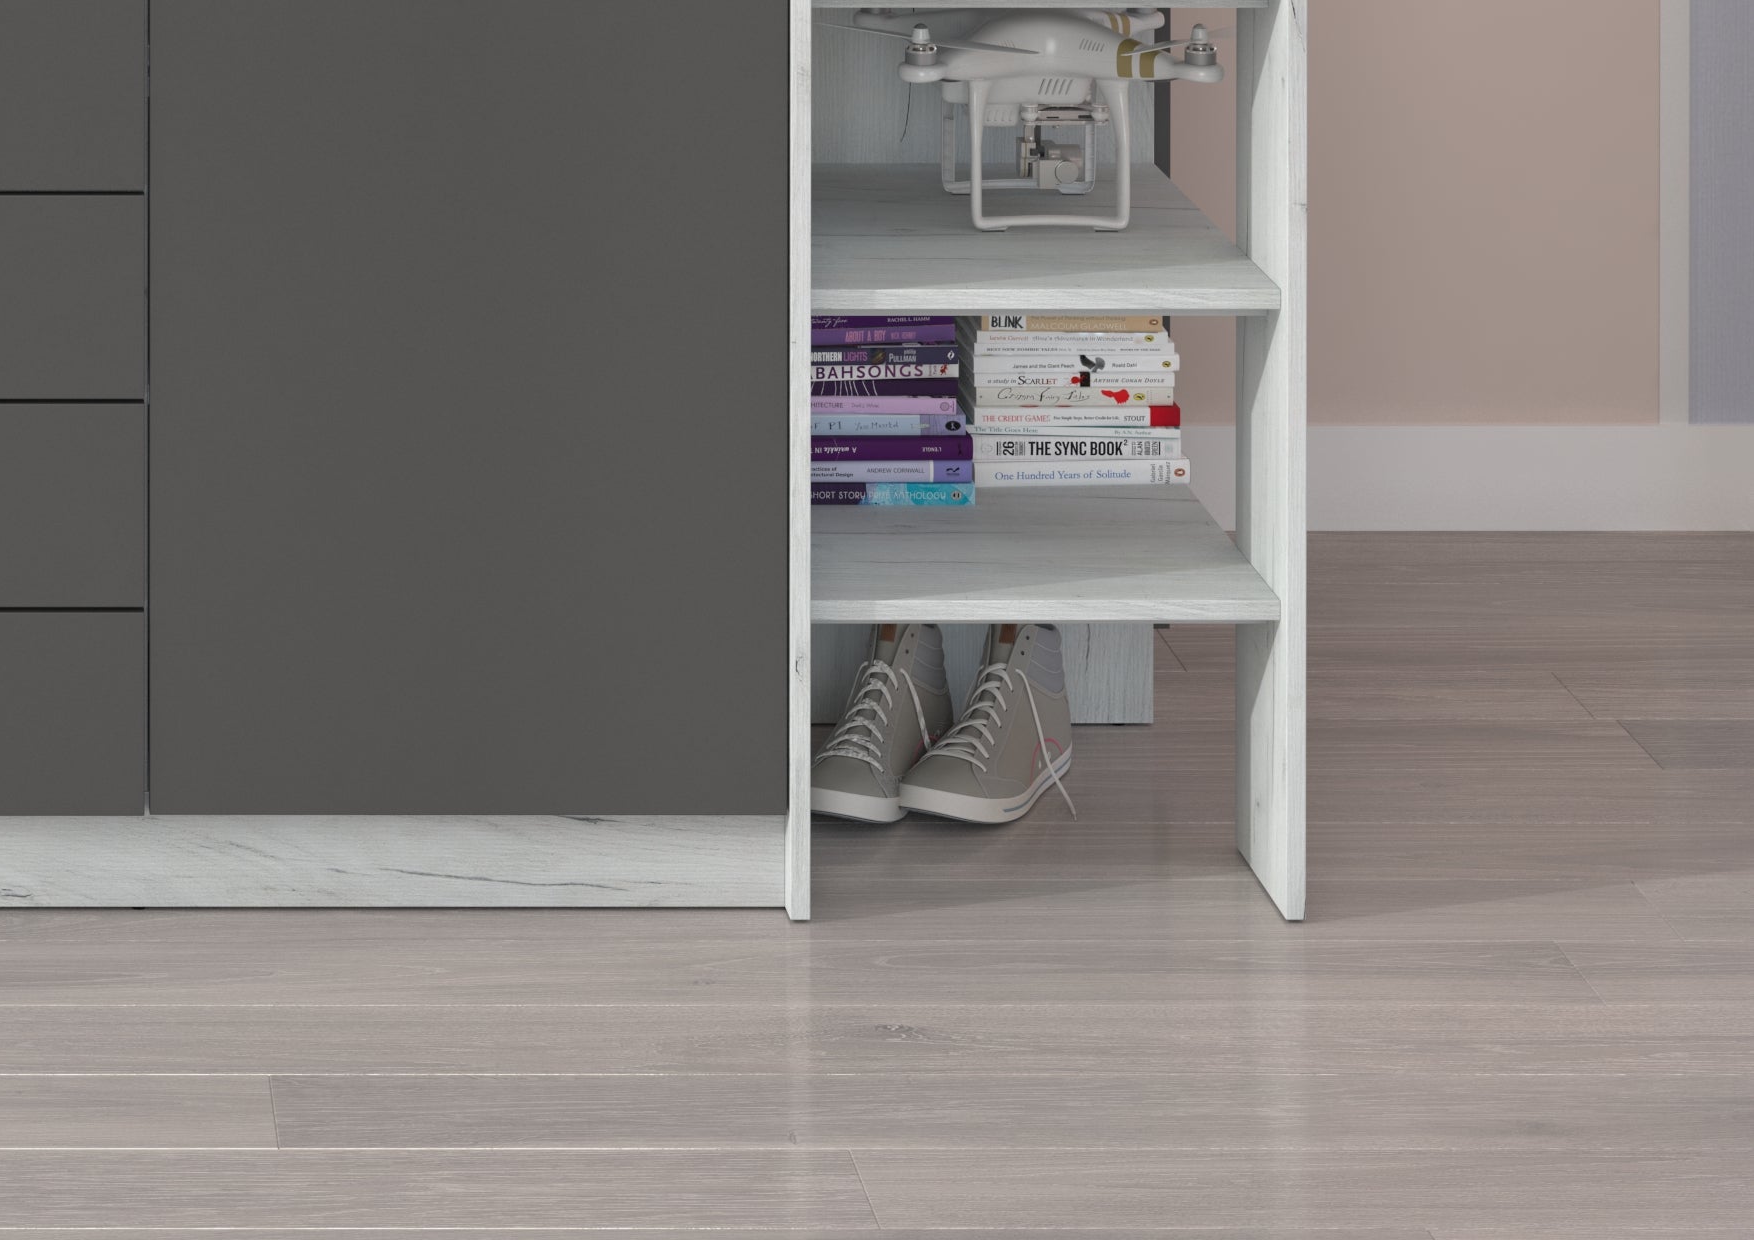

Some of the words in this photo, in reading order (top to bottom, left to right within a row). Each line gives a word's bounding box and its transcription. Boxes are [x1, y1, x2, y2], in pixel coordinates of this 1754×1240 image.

[991, 316, 1023, 328] BLINK
[845, 331, 865, 342] ABOUT
[867, 331, 871, 342] A
[874, 330, 886, 341] BOY
[843, 352, 867, 361] LIGHTS
[889, 353, 917, 362] PULLMAN
[811, 364, 923, 379] BAHSONGS
[1018, 376, 1057, 385] SCARLET
[997, 388, 1034, 401] Grimm
[1036, 388, 1059, 402] Fairy
[1003, 442, 1015, 456] 26
[1029, 441, 1051, 456] THE
[1054, 441, 1087, 456] SYNC
[995, 471, 1014, 481] One
[1017, 471, 1055, 480] Hundred
[1058, 470, 1081, 479] Years
[1083, 470, 1094, 479] of
[1096, 470, 1131, 479] Solitude
[838, 491, 865, 499] STORY
